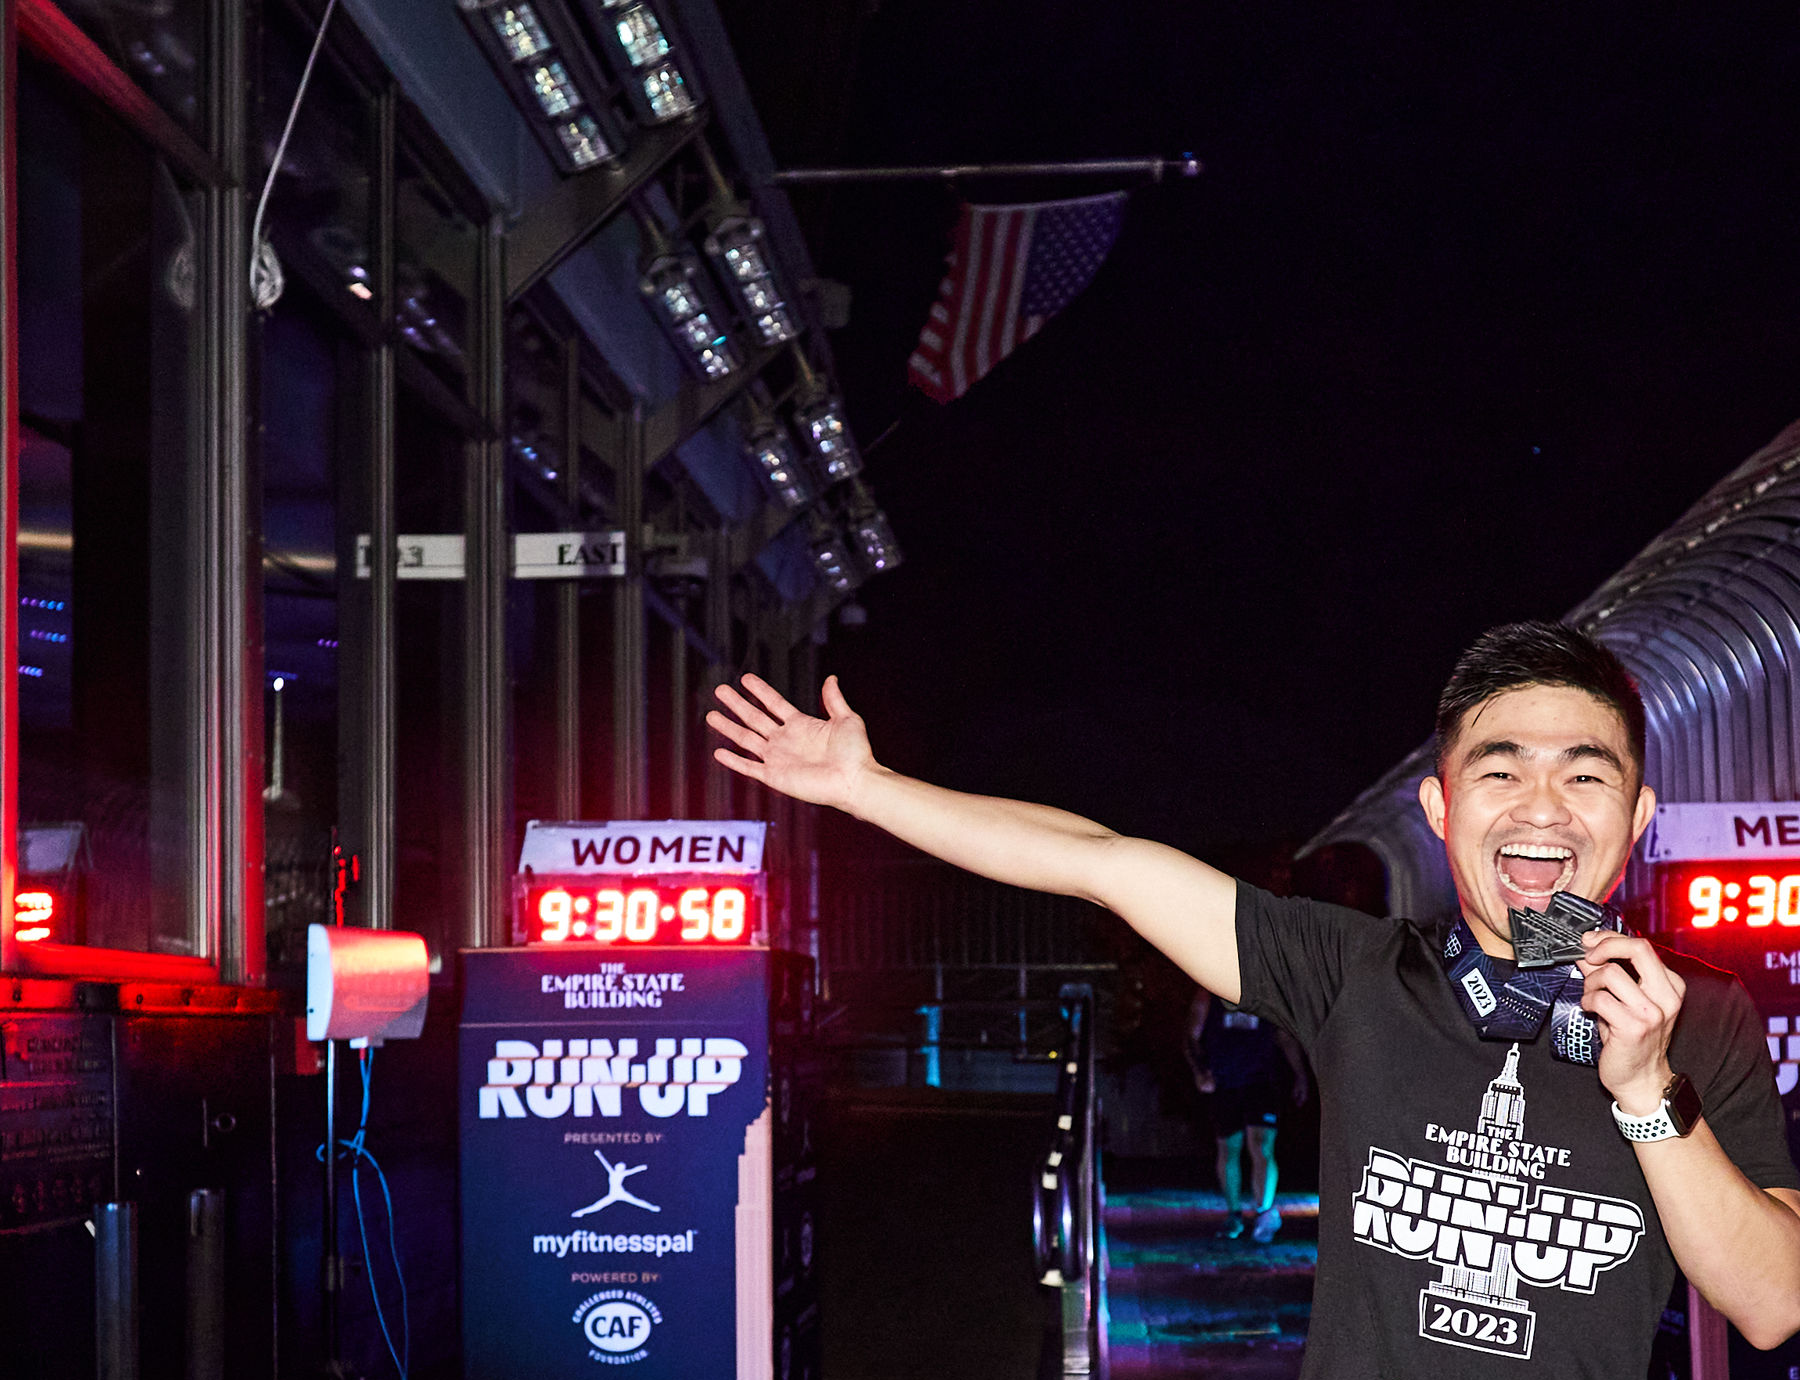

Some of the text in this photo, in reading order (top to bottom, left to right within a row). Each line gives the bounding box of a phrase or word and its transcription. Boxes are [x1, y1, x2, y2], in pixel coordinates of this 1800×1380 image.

[557, 543, 622, 565] EAST
[572, 836, 745, 866] WOMEN
[600, 962, 626, 974] THE
[541, 973, 686, 993] EMPIRE STATE
[1467, 975, 1492, 1009] 2023
[564, 991, 663, 1009] BUILDING
[564, 1132, 642, 1144] PRESENTED
[1487, 1125, 1514, 1141] THE
[1425, 1123, 1572, 1167] EMPIRE STATE
[1446, 1145, 1546, 1180] BUILDING
[533, 1229, 695, 1258] myfitnesspal
[571, 1272, 639, 1284] POWERED
[591, 1316, 642, 1338] CAF
[1431, 1303, 1519, 1346] 2023
